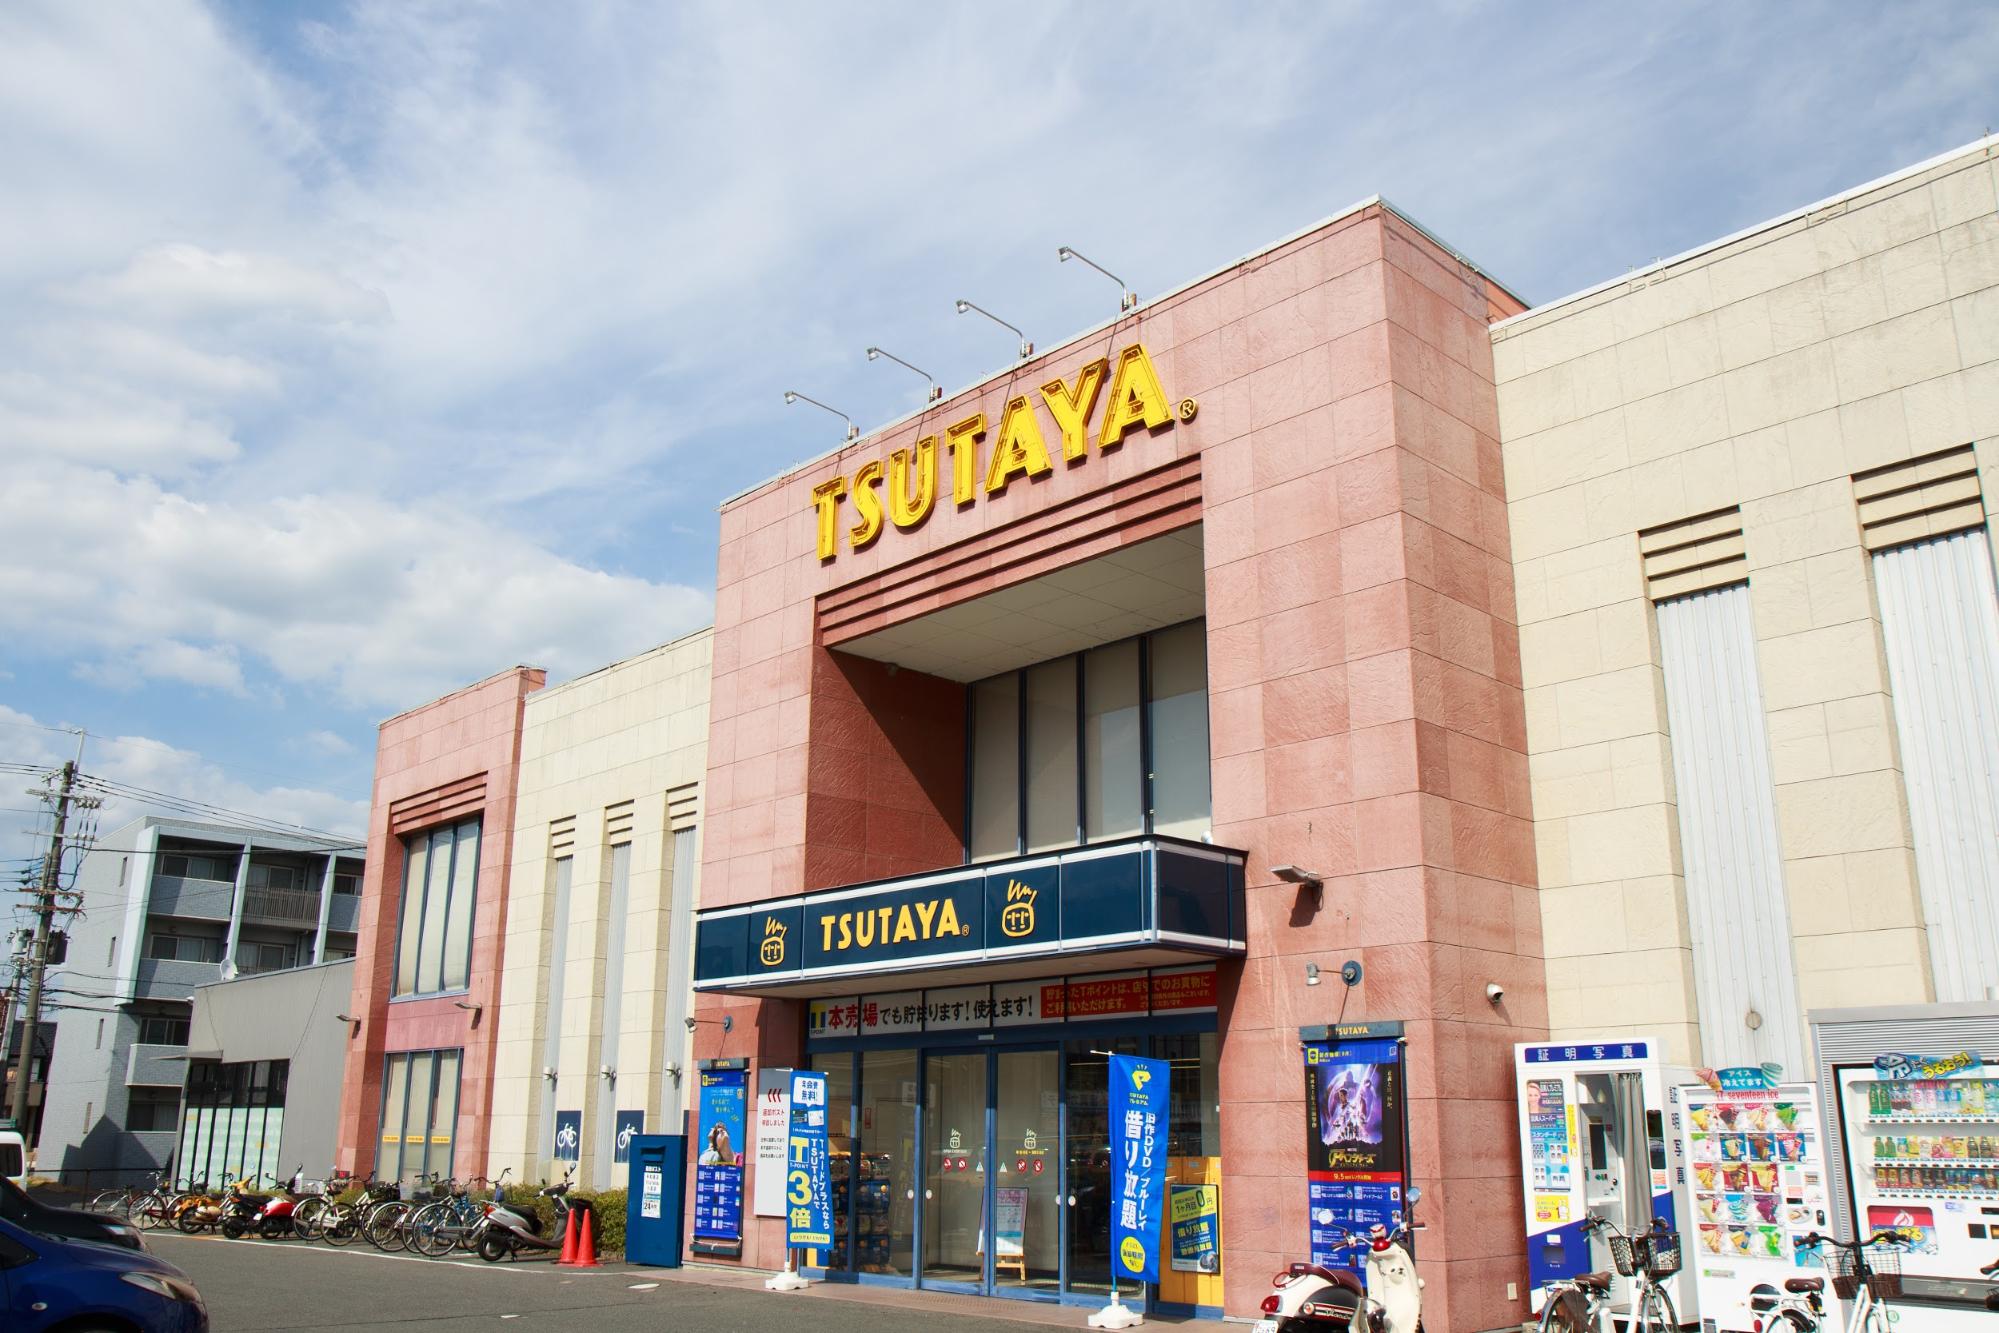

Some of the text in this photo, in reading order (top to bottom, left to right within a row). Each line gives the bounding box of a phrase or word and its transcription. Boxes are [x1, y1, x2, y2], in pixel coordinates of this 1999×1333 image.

[1537, 1045, 1634, 1061] 証明写真
[1727, 1069, 1752, 1077] アイス
[1722, 1078, 1762, 1087] 冷えてます
[1120, 1109, 1144, 1230] 借り放題
